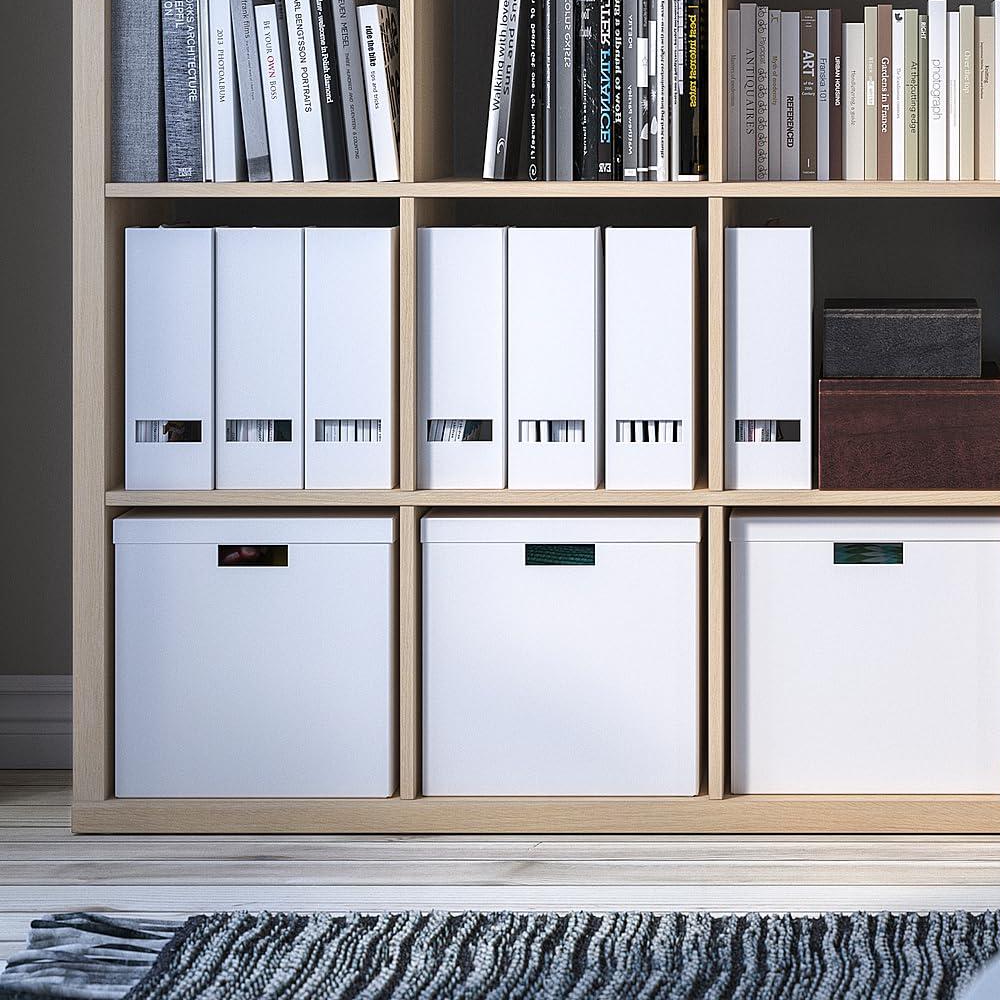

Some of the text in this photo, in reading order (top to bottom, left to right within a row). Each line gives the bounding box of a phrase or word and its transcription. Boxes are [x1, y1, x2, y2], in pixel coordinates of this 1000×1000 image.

[241, 0, 250, 19] frank
[243, 20, 251, 39] films
[295, 14, 307, 63] BENGTSSON
[341, 23, 350, 49] MEISEL
[365, 25, 377, 67] ride the bike
[492, 0, 509, 111] Walking with love
[507, 28, 515, 60] and
[187, 25, 197, 102] ARCHITECTURE
[218, 49, 226, 103] PHOTOALBUM
[263, 21, 278, 100] BE YOUR OWN BOSS
[503, 65, 512, 96] Sun
[803, 50, 815, 77] ART
[300, 66, 312, 113] PORTRAITS
[744, 49, 754, 134] ANTIQUAIRES
[882, 94, 889, 102] in
[909, 61, 918, 133] At cutting edge
[931, 59, 943, 120] photograph
